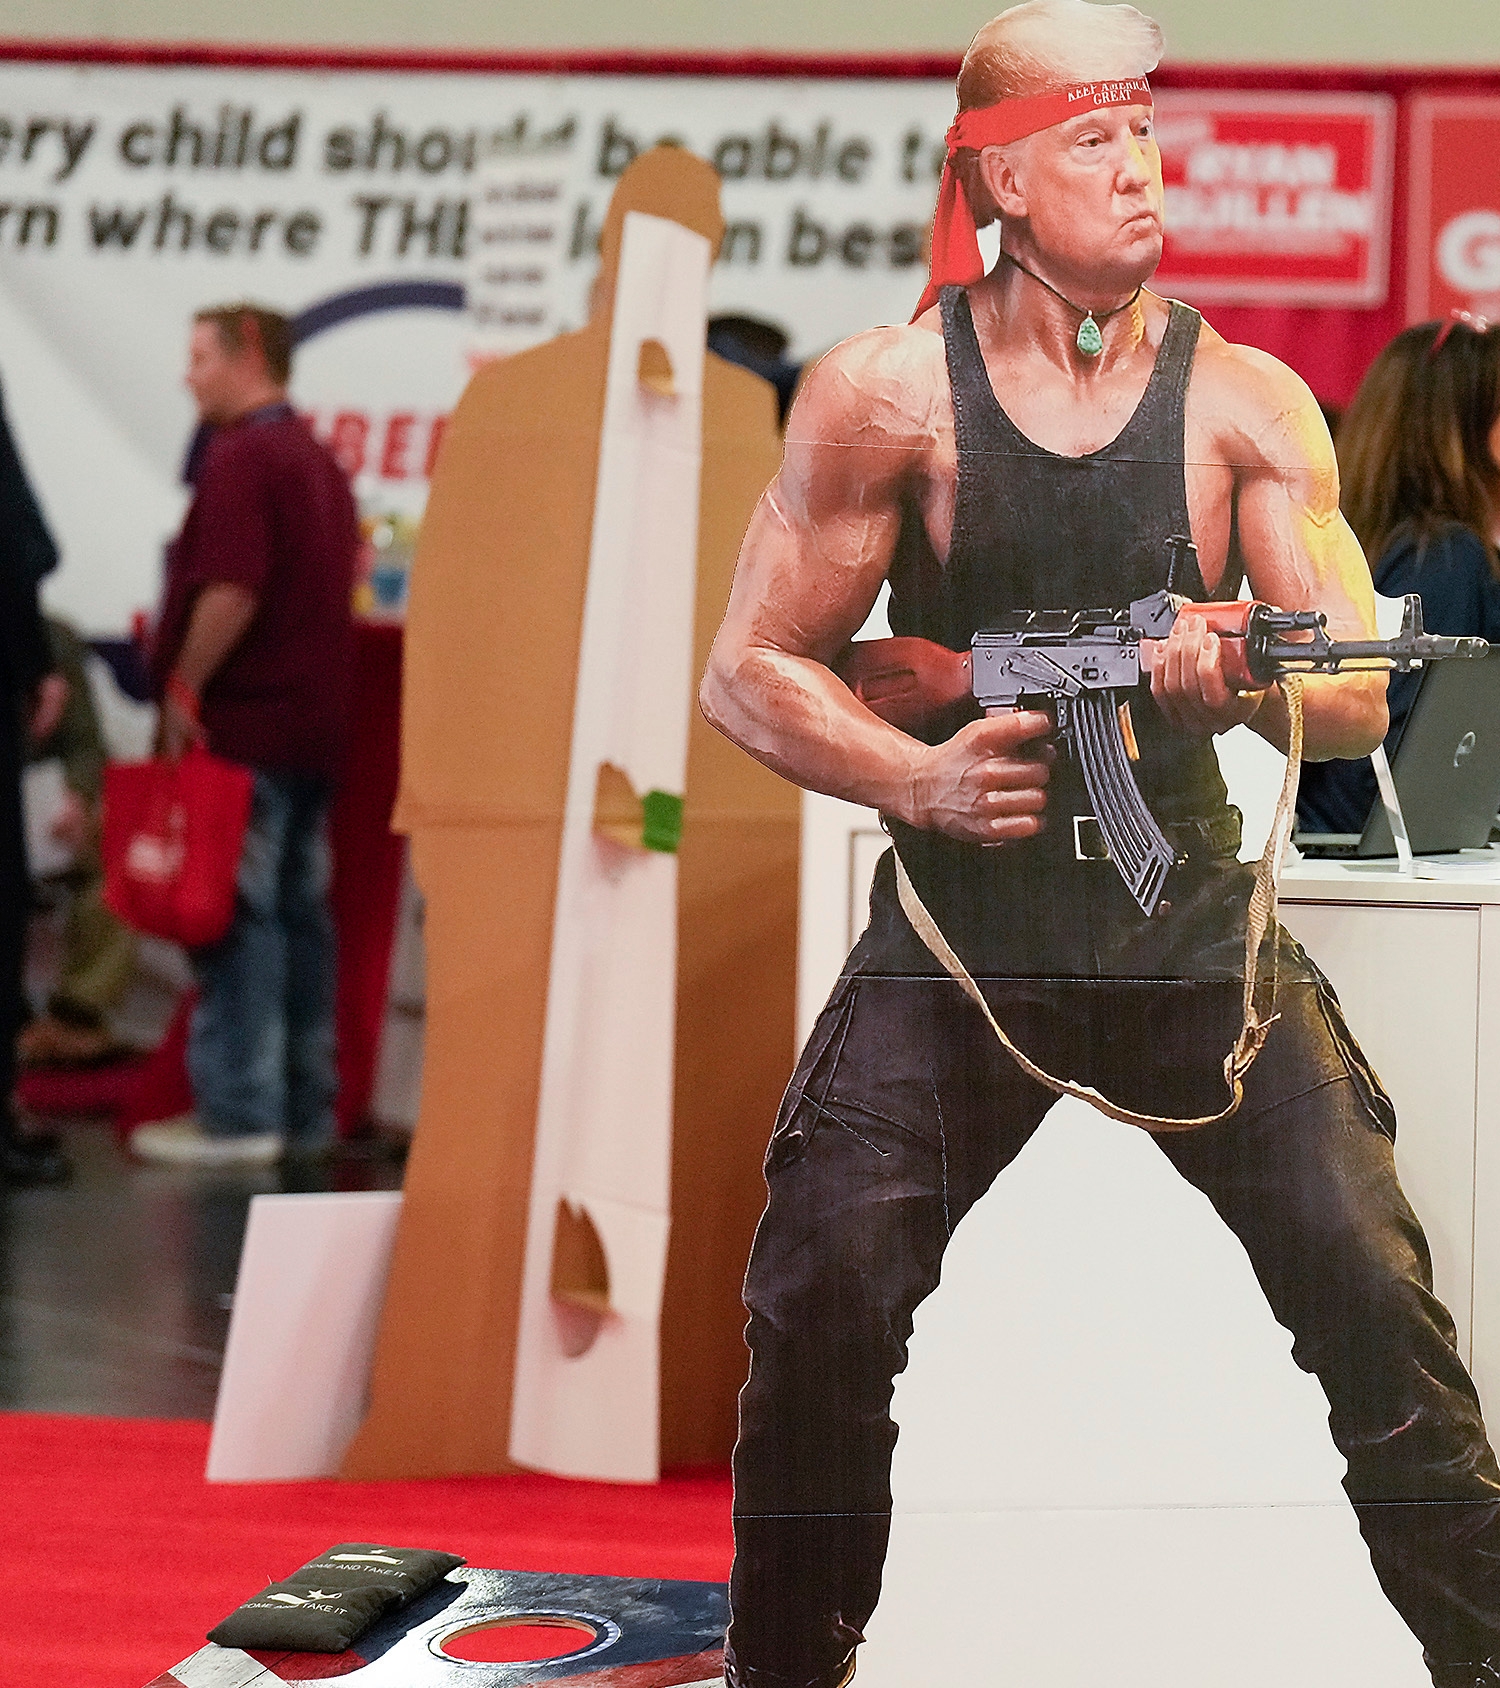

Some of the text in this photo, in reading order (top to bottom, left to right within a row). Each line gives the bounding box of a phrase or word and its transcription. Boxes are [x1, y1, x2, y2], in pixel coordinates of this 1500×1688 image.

[1101, 80, 1150, 93] AMERICA
[1093, 89, 1132, 105] GREAT
[118, 102, 302, 171] child
[713, 115, 870, 183] able
[88, 192, 323, 256] where
[350, 193, 470, 260] TH
[787, 203, 930, 268] bes
[336, 1563, 362, 1571] AND
[363, 1565, 393, 1577] TAKE
[301, 1602, 333, 1613] TAKE
[333, 1607, 348, 1615] IT
